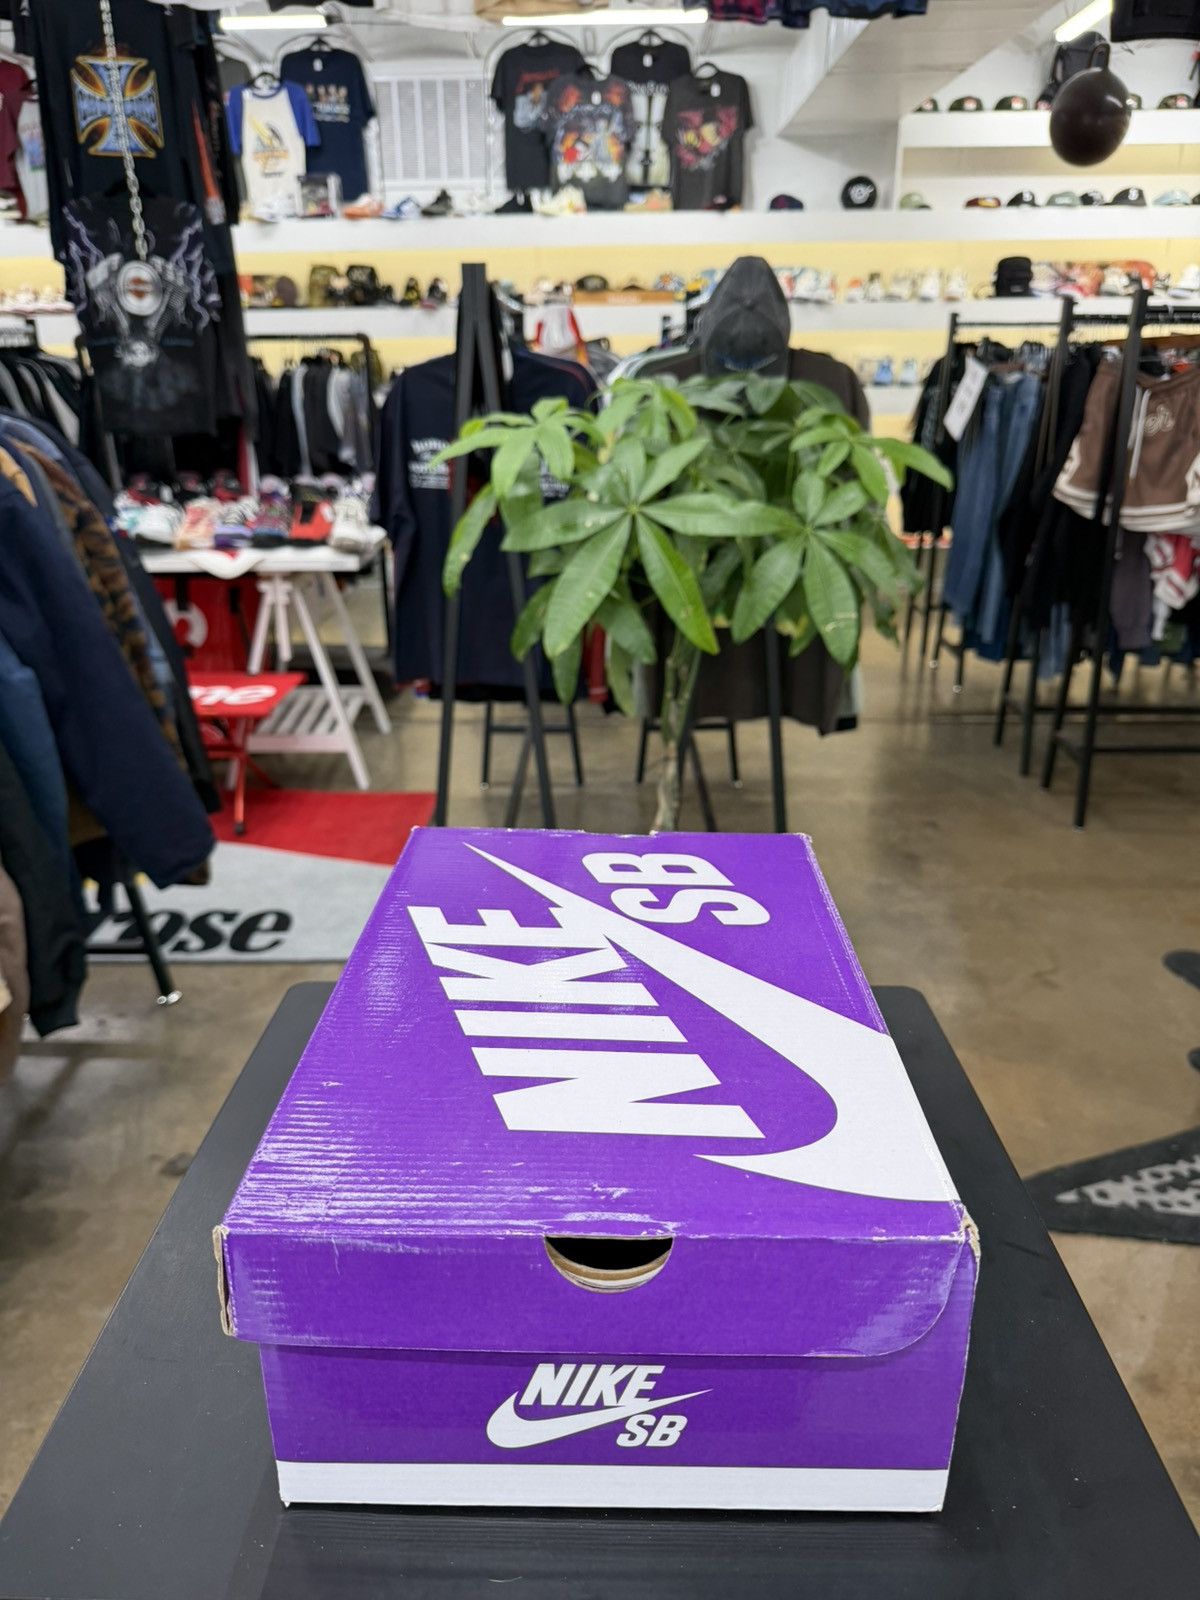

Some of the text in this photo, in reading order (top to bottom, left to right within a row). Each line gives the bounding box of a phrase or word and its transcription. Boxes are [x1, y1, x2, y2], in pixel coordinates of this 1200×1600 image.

[581, 852, 771, 927] SB
[407, 905, 766, 1139] NIKE
[519, 1363, 666, 1407] NIKE
[616, 1414, 688, 1447] SB
